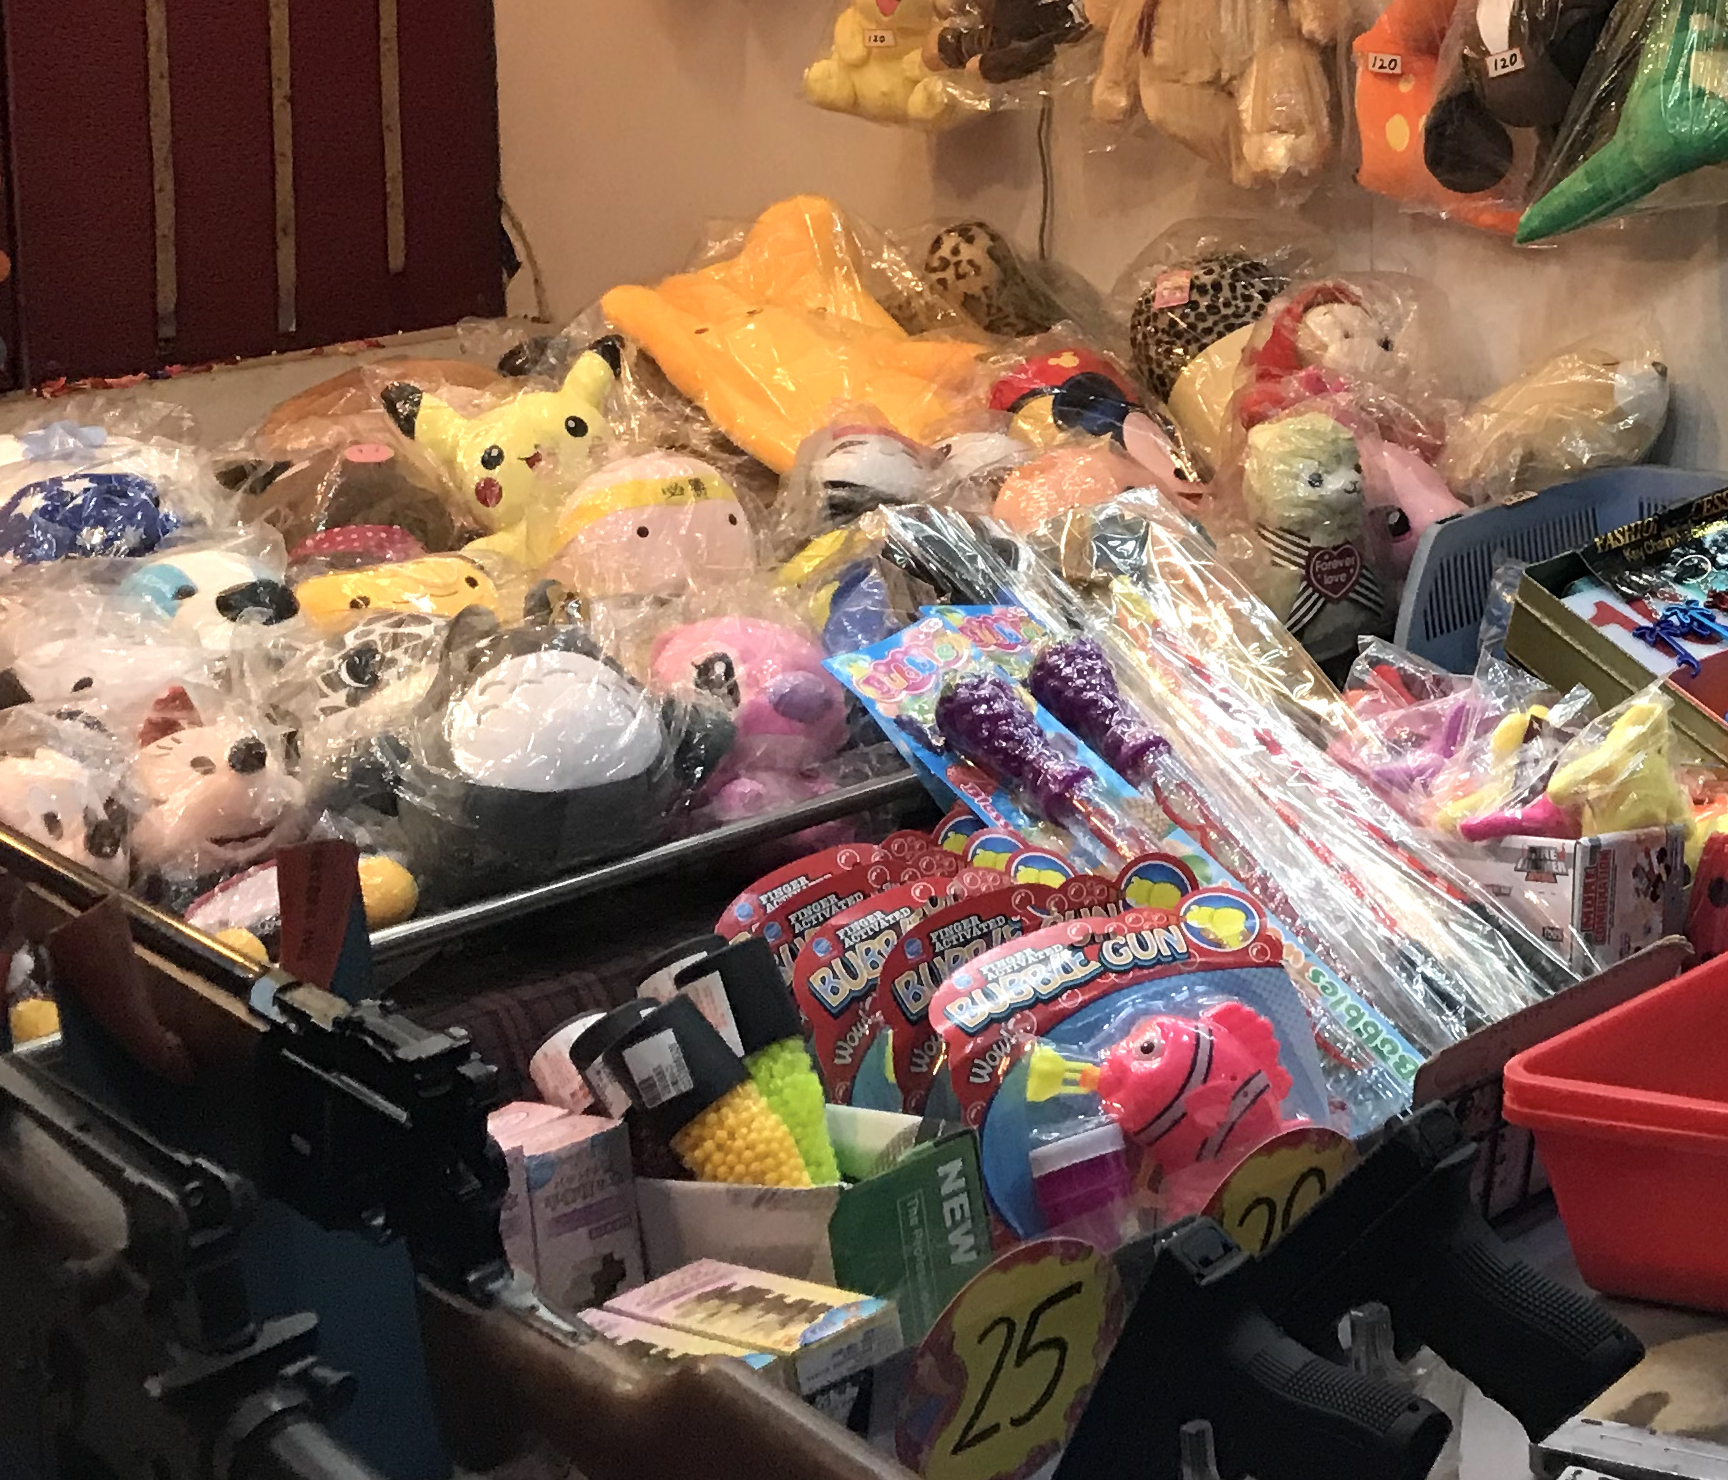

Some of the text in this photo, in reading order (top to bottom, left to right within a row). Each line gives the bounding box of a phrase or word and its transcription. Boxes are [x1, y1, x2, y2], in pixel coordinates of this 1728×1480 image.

[1371, 55, 1398, 71] 120
[1493, 52, 1518, 72] 120
[1315, 556, 1355, 573] Forever
[1324, 573, 1347, 585] love
[759, 875, 809, 905] FINGER
[789, 894, 839, 924] FINGER
[794, 891, 864, 933] ACTIVATED
[836, 910, 885, 940] FINGER
[844, 907, 911, 948] ACTIVATED
[930, 916, 982, 942] FINGER
[934, 916, 1006, 952] ACTIVATED
[945, 925, 1189, 1028] BUBBLE GUN
[980, 947, 1037, 976] FINGER
[984, 944, 1064, 981] ACTIVATED
[936, 1157, 977, 1265] NEW
[951, 1280, 1083, 1456] 25
